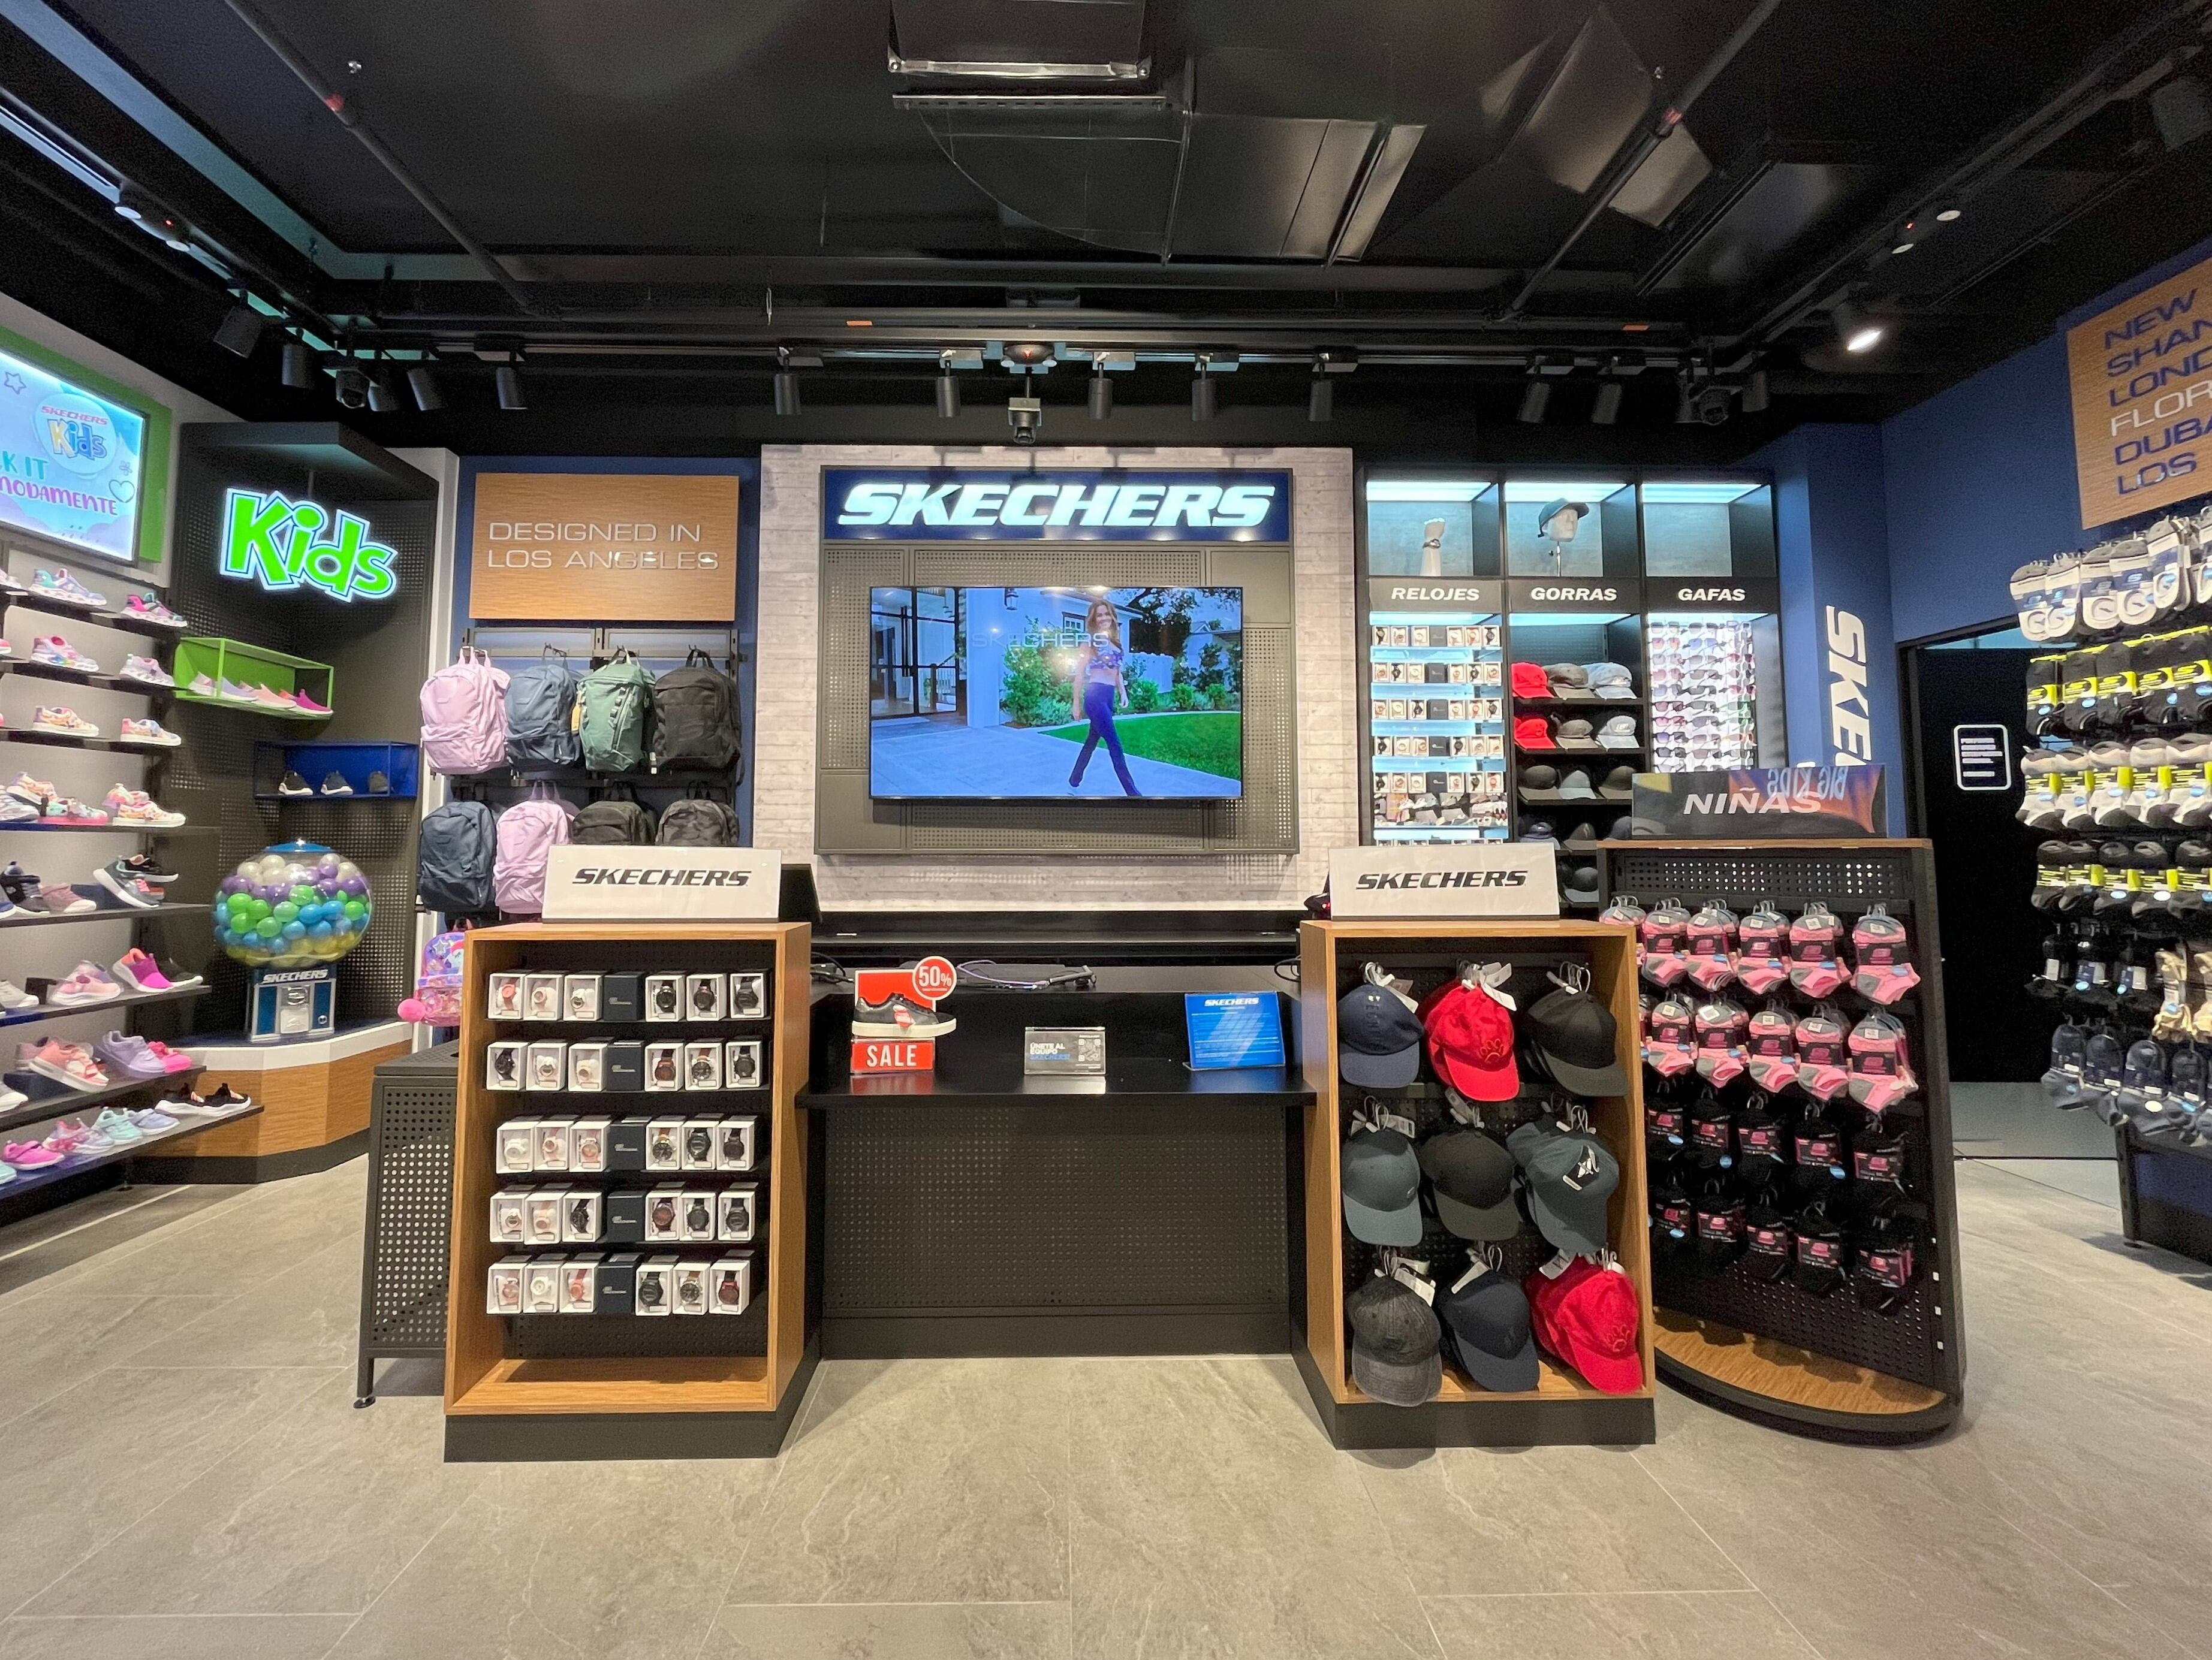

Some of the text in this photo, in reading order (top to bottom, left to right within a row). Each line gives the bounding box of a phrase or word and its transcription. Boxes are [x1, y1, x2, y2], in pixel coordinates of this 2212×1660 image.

[2105, 288, 2198, 350] NEW
[41, 406, 109, 425] SKECHERS
[2111, 379, 2212, 437] FLOR
[47, 418, 107, 461] Kids
[0, 451, 48, 479] K IT
[2118, 452, 2197, 495] LOS
[838, 483, 1276, 527] SKECHERS
[489, 522, 701, 542] DESIGNED IN
[222, 489, 397, 601] Kids
[488, 549, 719, 570] LOS ANGELES
[1391, 587, 1480, 602] RELOJES
[1530, 587, 1617, 602] GORRAS
[1678, 587, 1746, 602] GAFAS
[972, 632, 1110, 648] SKECHERS
[1683, 786, 1822, 815] NIÑAS
[572, 868, 752, 886] SKECHERS
[1355, 870, 1529, 890] SKECHERS
[262, 968, 329, 983] SKECHERS
[918, 965, 952, 988] 50%
[1204, 997, 1259, 1007] SKECHERS
[866, 1045, 917, 1067] SALE
